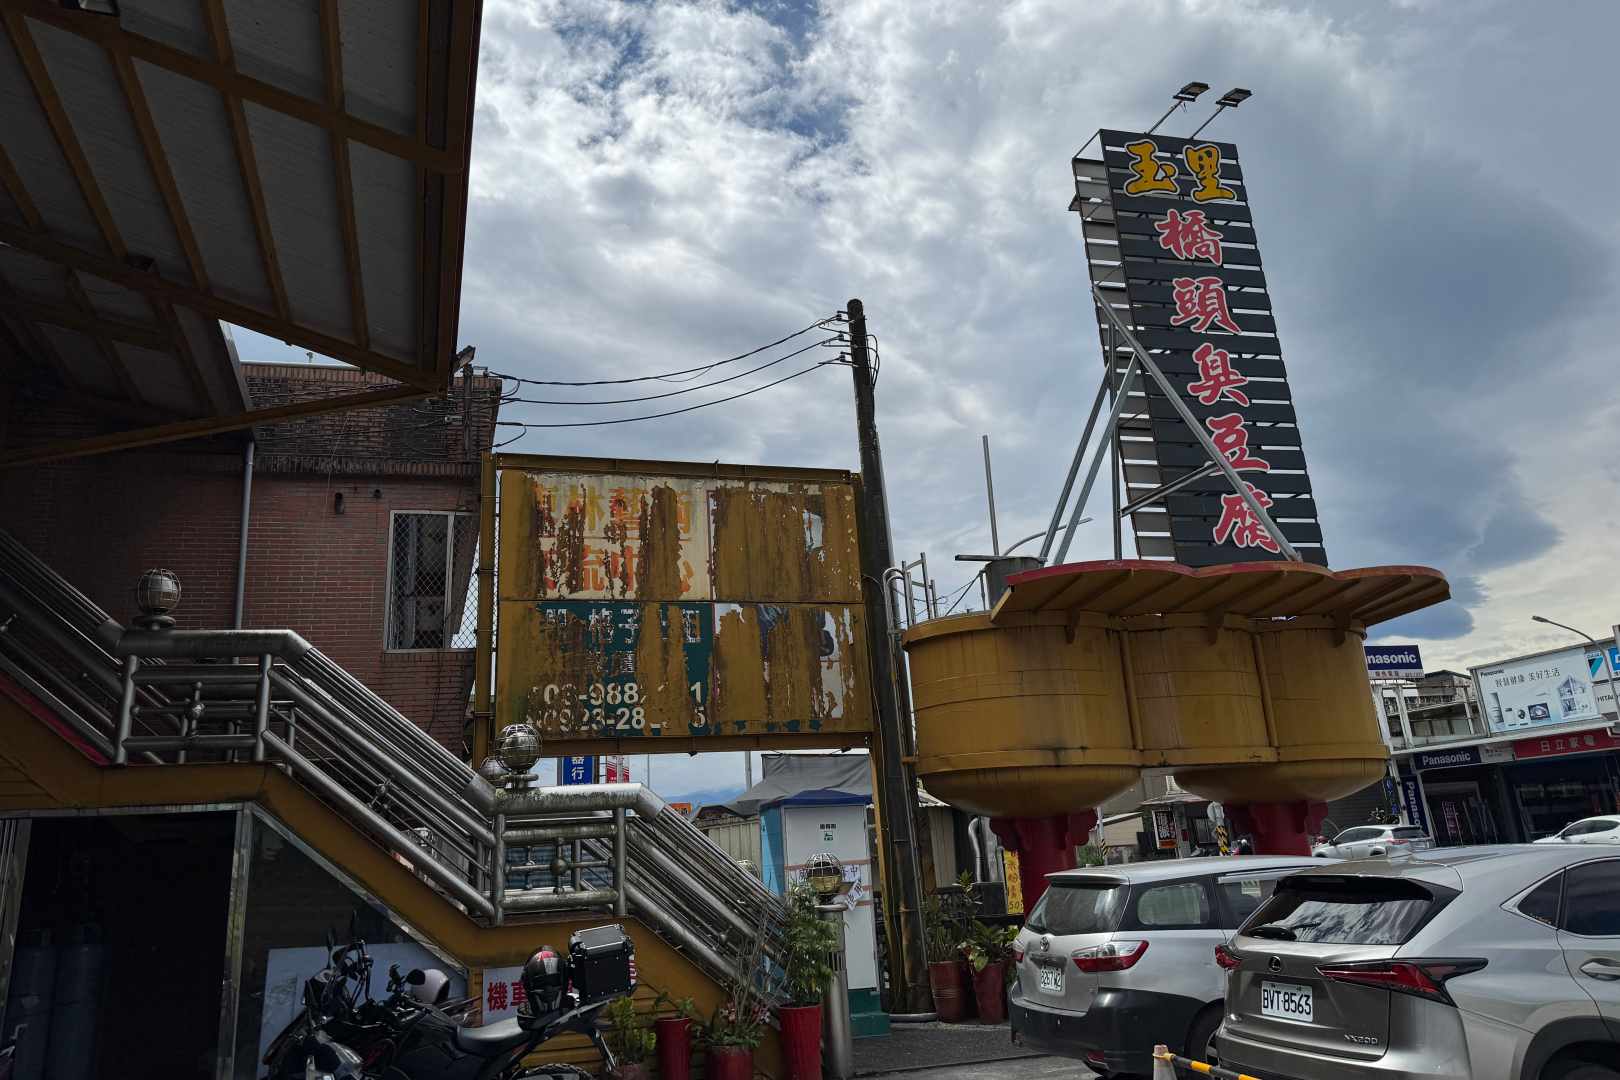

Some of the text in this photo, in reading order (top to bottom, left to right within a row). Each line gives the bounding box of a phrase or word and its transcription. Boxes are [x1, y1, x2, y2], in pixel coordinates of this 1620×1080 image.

[1124, 140, 1237, 203] 玉里
[1422, 752, 1471, 767] Panasonic
[1263, 989, 1312, 1015] BVT-8563
